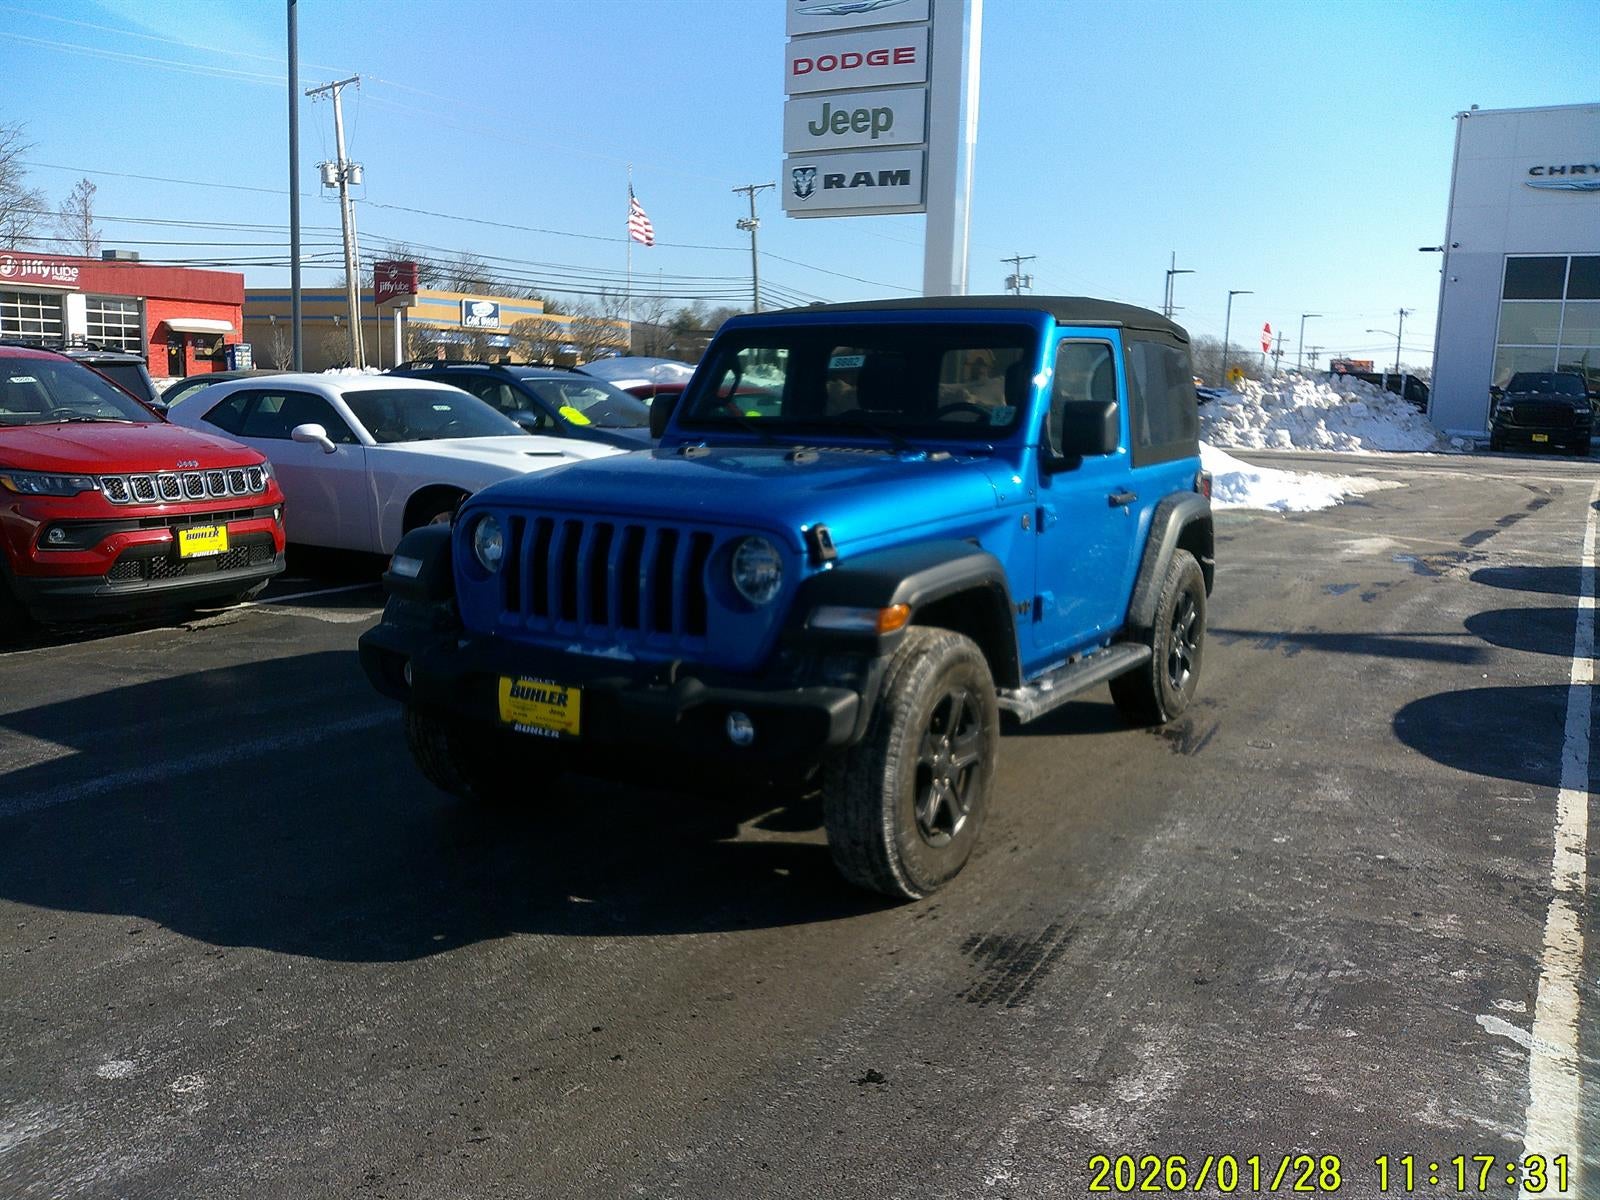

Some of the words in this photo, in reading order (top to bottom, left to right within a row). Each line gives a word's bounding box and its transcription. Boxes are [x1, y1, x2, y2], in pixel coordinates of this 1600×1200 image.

[793, 46, 916, 75] DODGE
[808, 101, 894, 140] Jeep
[823, 169, 911, 190] RAM
[21, 259, 51, 278] jiffy
[51, 262, 79, 277] lube
[379, 281, 395, 294] jiffy
[466, 315, 480, 327] CAR
[480, 316, 498, 328] WASH
[186, 530, 220, 541] BUHLER
[510, 685, 568, 707] BUHLER
[513, 723, 561, 739] BUHLER
